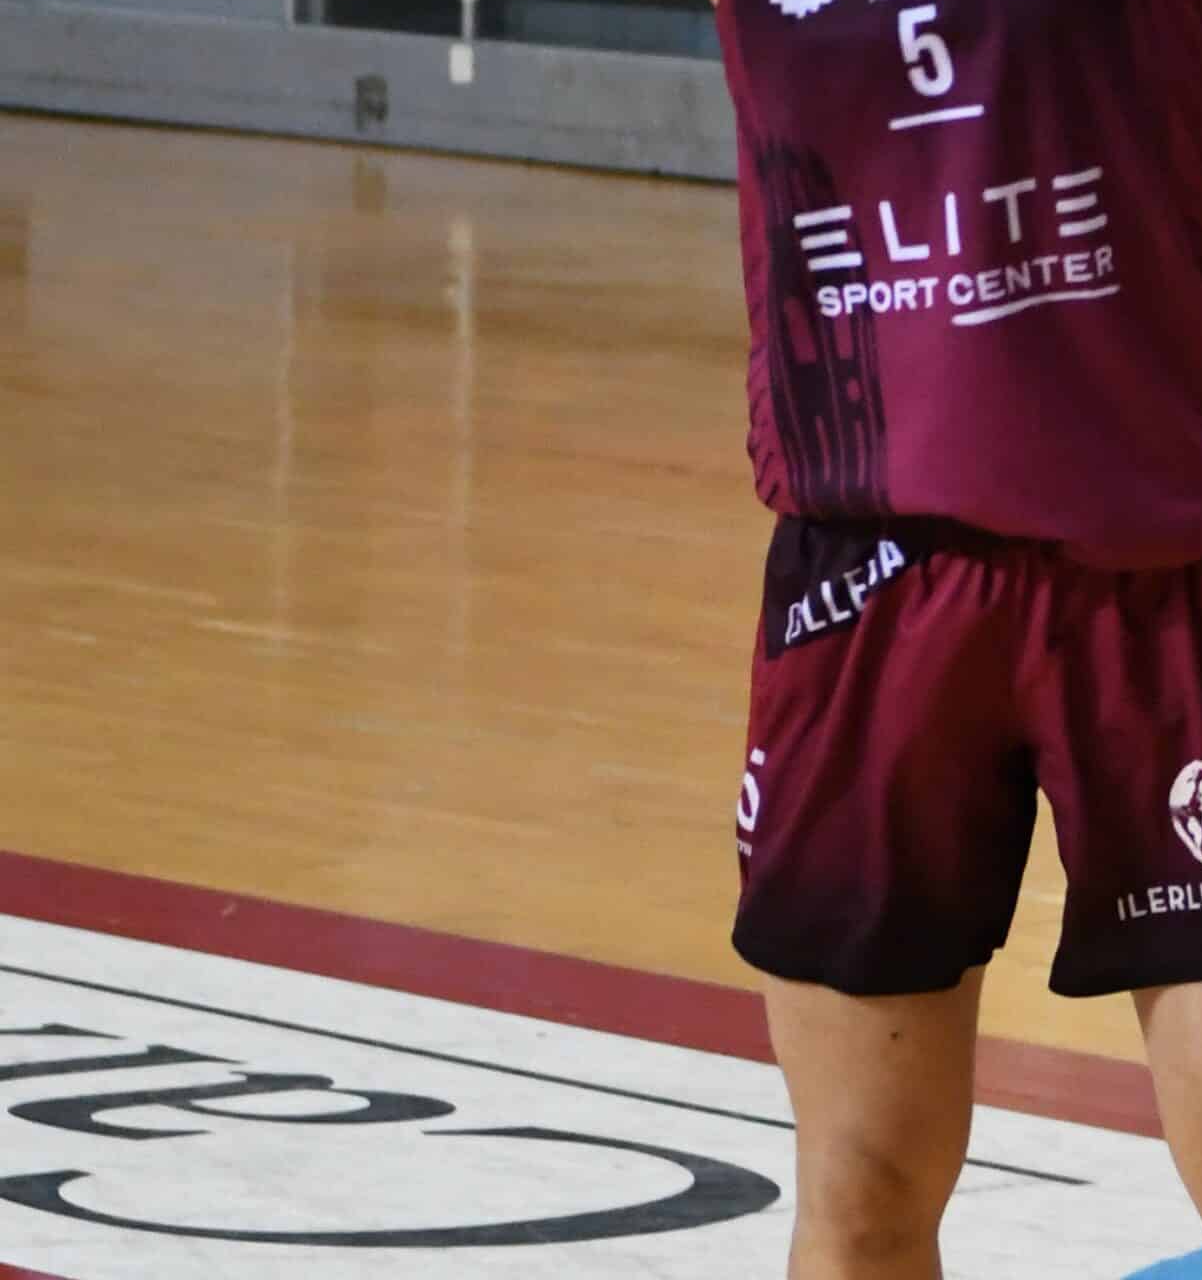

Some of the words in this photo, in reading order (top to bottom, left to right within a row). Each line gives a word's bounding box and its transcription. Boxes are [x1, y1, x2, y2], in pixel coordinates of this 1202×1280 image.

[898, 3, 954, 97] 5
[793, 166, 1107, 271] ELITE
[816, 276, 940, 317] SPORT
[947, 245, 1115, 306] CENTER
